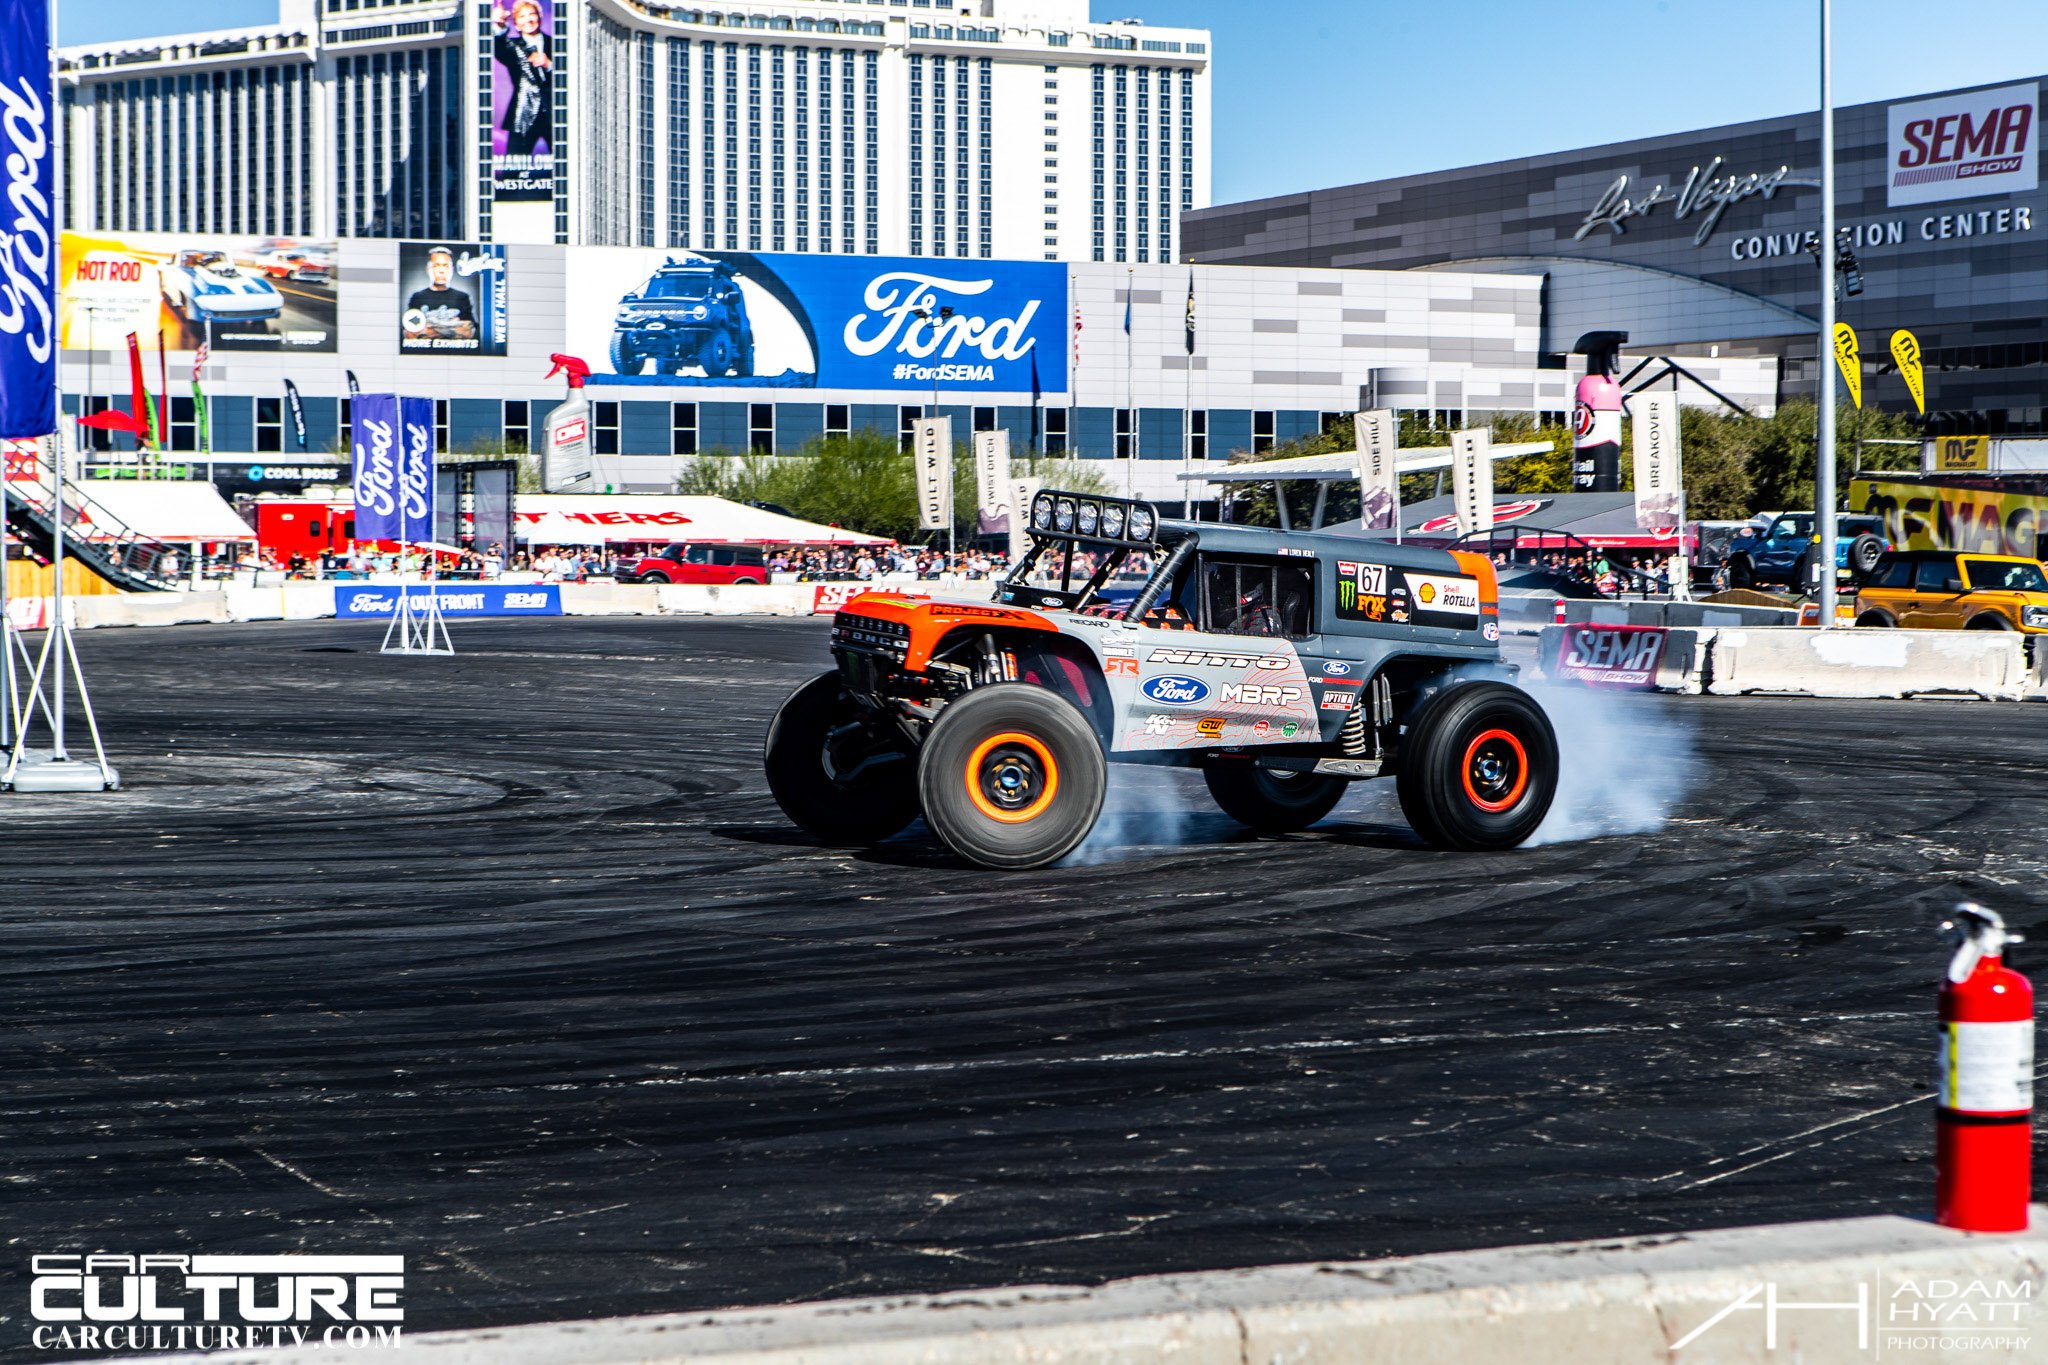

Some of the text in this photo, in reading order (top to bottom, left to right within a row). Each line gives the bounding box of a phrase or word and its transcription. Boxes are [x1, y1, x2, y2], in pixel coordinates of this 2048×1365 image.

[1898, 103, 2033, 169] SEMA
[1958, 159, 2020, 176] SHOW
[493, 179, 554, 190] WESTGATE
[1574, 156, 1821, 247] Las Vegas
[1731, 207, 2031, 260] CONVEION CENTER
[77, 261, 141, 282] HOT ROD
[495, 279, 506, 343] WEST HALL
[844, 272, 1041, 361] Ford
[893, 363, 995, 381] #FordSEMA
[1650, 401, 1660, 489] BREAKOVER
[354, 418, 395, 516] Ford
[399, 423, 429, 519] Ford
[1371, 447, 1382, 476] SIDE
[264, 468, 339, 479] COOL BOSS
[927, 427, 940, 523] BUILT WILD
[987, 475, 995, 506] TWIST
[1362, 566, 1382, 592] 67
[1443, 585, 1459, 593] Shell
[349, 593, 394, 612] Ford
[439, 594, 485, 610] FRONT
[933, 605, 1024, 620] PROJECT X
[1357, 595, 1387, 619] FOX
[1443, 595, 1476, 608] ROTELLA
[1069, 618, 1110, 628] RECARO
[831, 628, 910, 648] BRONCO
[1146, 649, 1290, 670] NITTO
[1565, 630, 1663, 670] SEMA
[1605, 672, 1648, 681] SHOW
[1153, 678, 1199, 701] Ford
[1220, 683, 1302, 706] MBRP
[1324, 692, 1353, 704] OPTIMA
